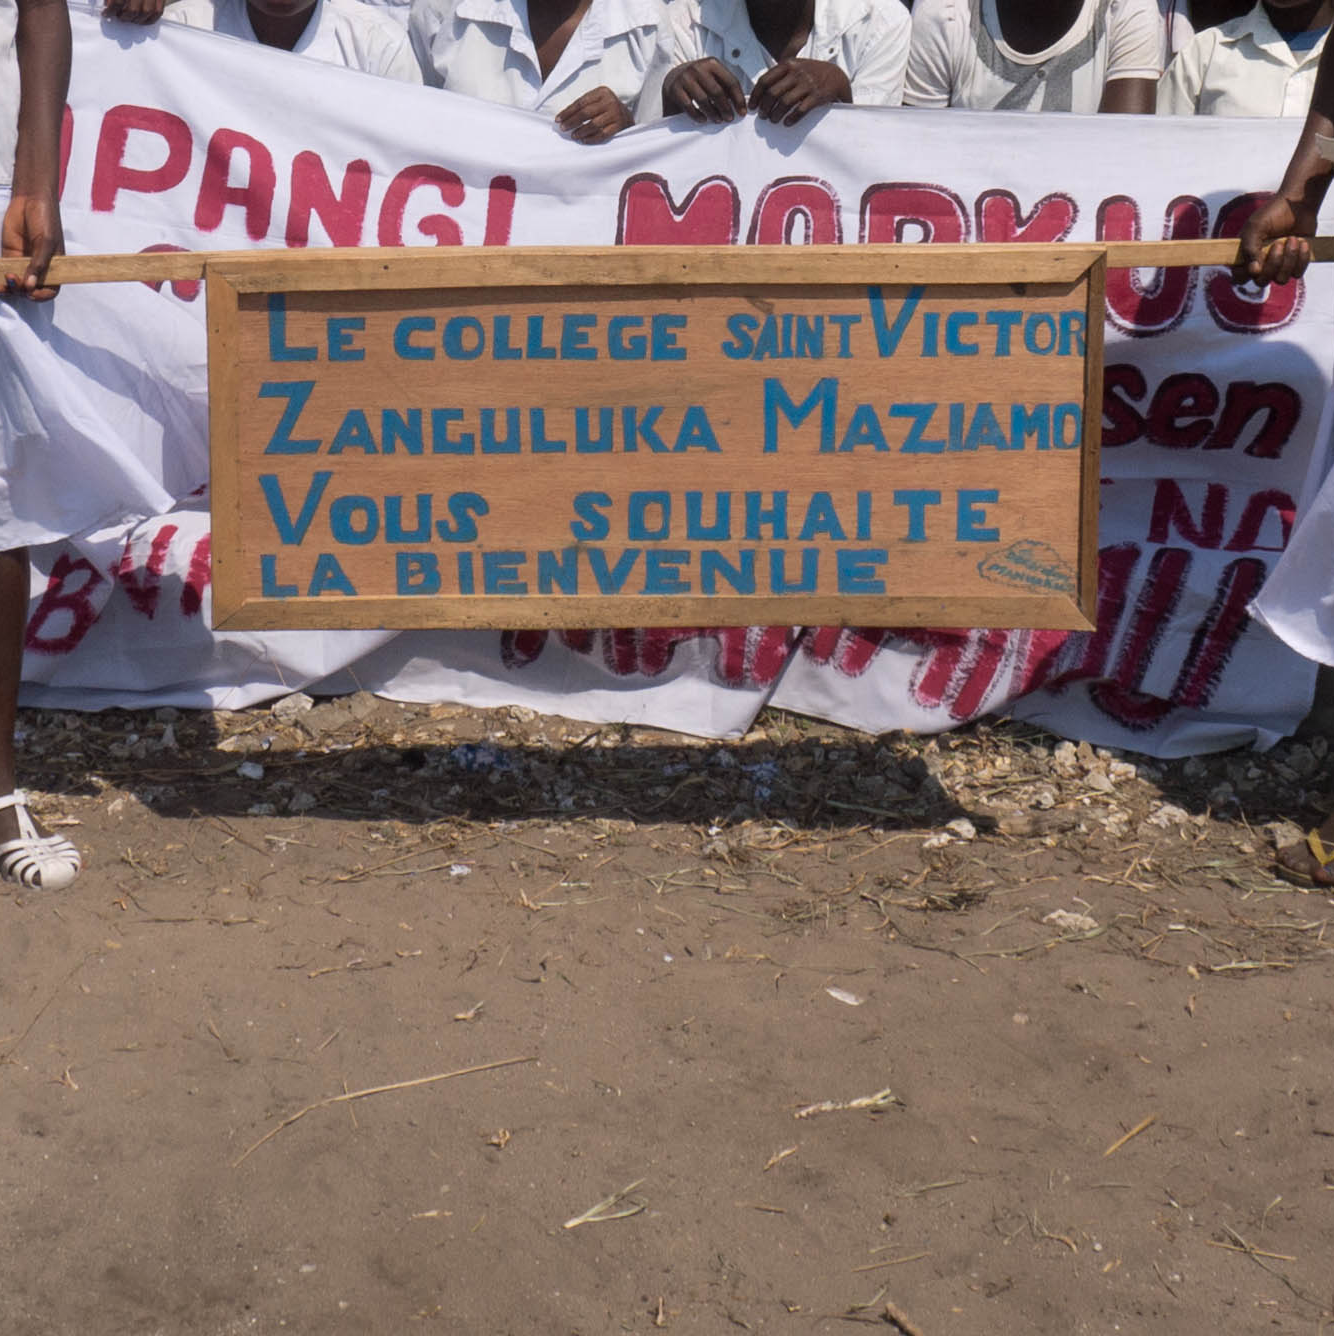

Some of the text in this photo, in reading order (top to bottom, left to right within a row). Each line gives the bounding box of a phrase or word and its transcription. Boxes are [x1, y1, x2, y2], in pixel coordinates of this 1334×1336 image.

[59, 104, 518, 246] PANGI
[394, 314, 688, 362] COLLEGE
[721, 312, 862, 361] SAINT
[867, 285, 1087, 358] VICTOR
[258, 470, 1002, 546] VOUS SOUHAITE
[261, 547, 889, 597] LA BIENVENUE
